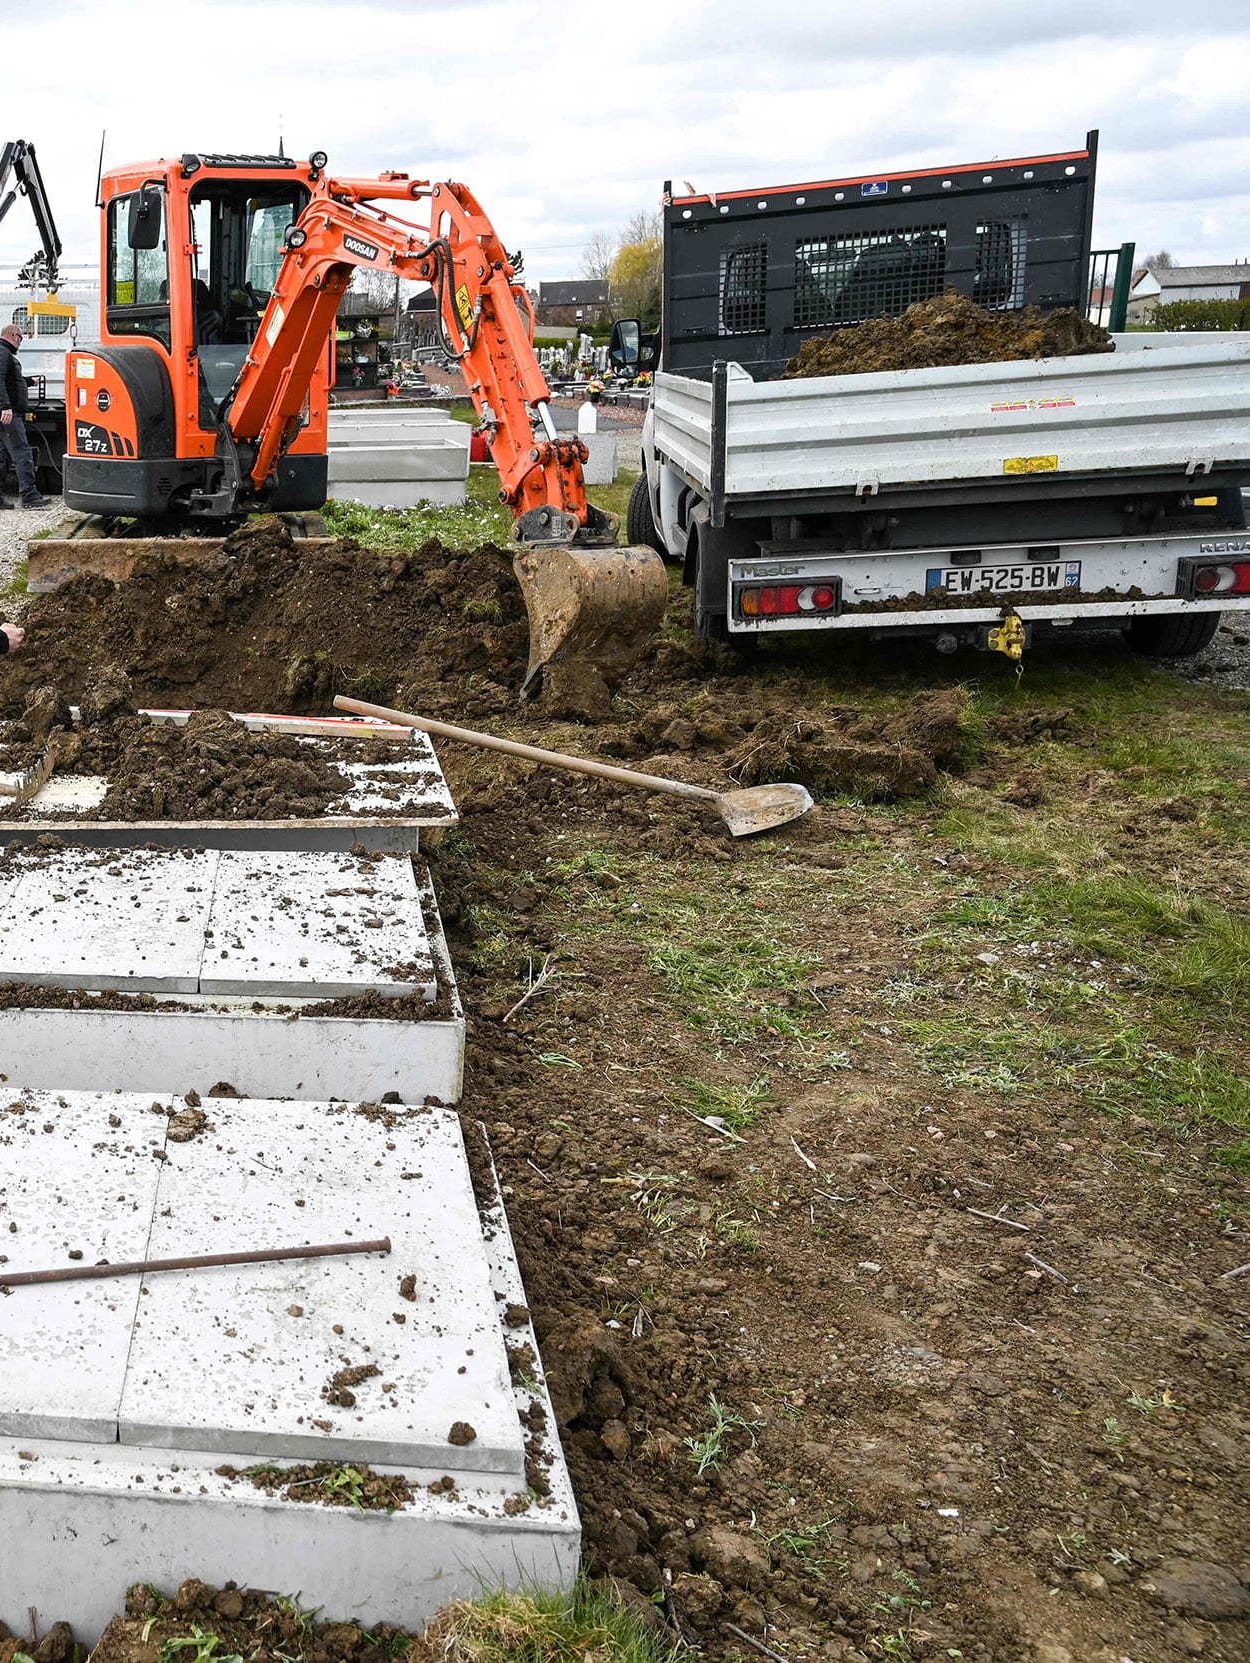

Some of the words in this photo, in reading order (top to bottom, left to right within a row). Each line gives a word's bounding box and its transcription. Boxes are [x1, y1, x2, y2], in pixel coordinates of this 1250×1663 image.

[345, 238, 376, 258] DOOSAN
[77, 425, 96, 438] DX
[740, 563, 806, 578] Master
[945, 565, 1061, 592] EW-525-BW
